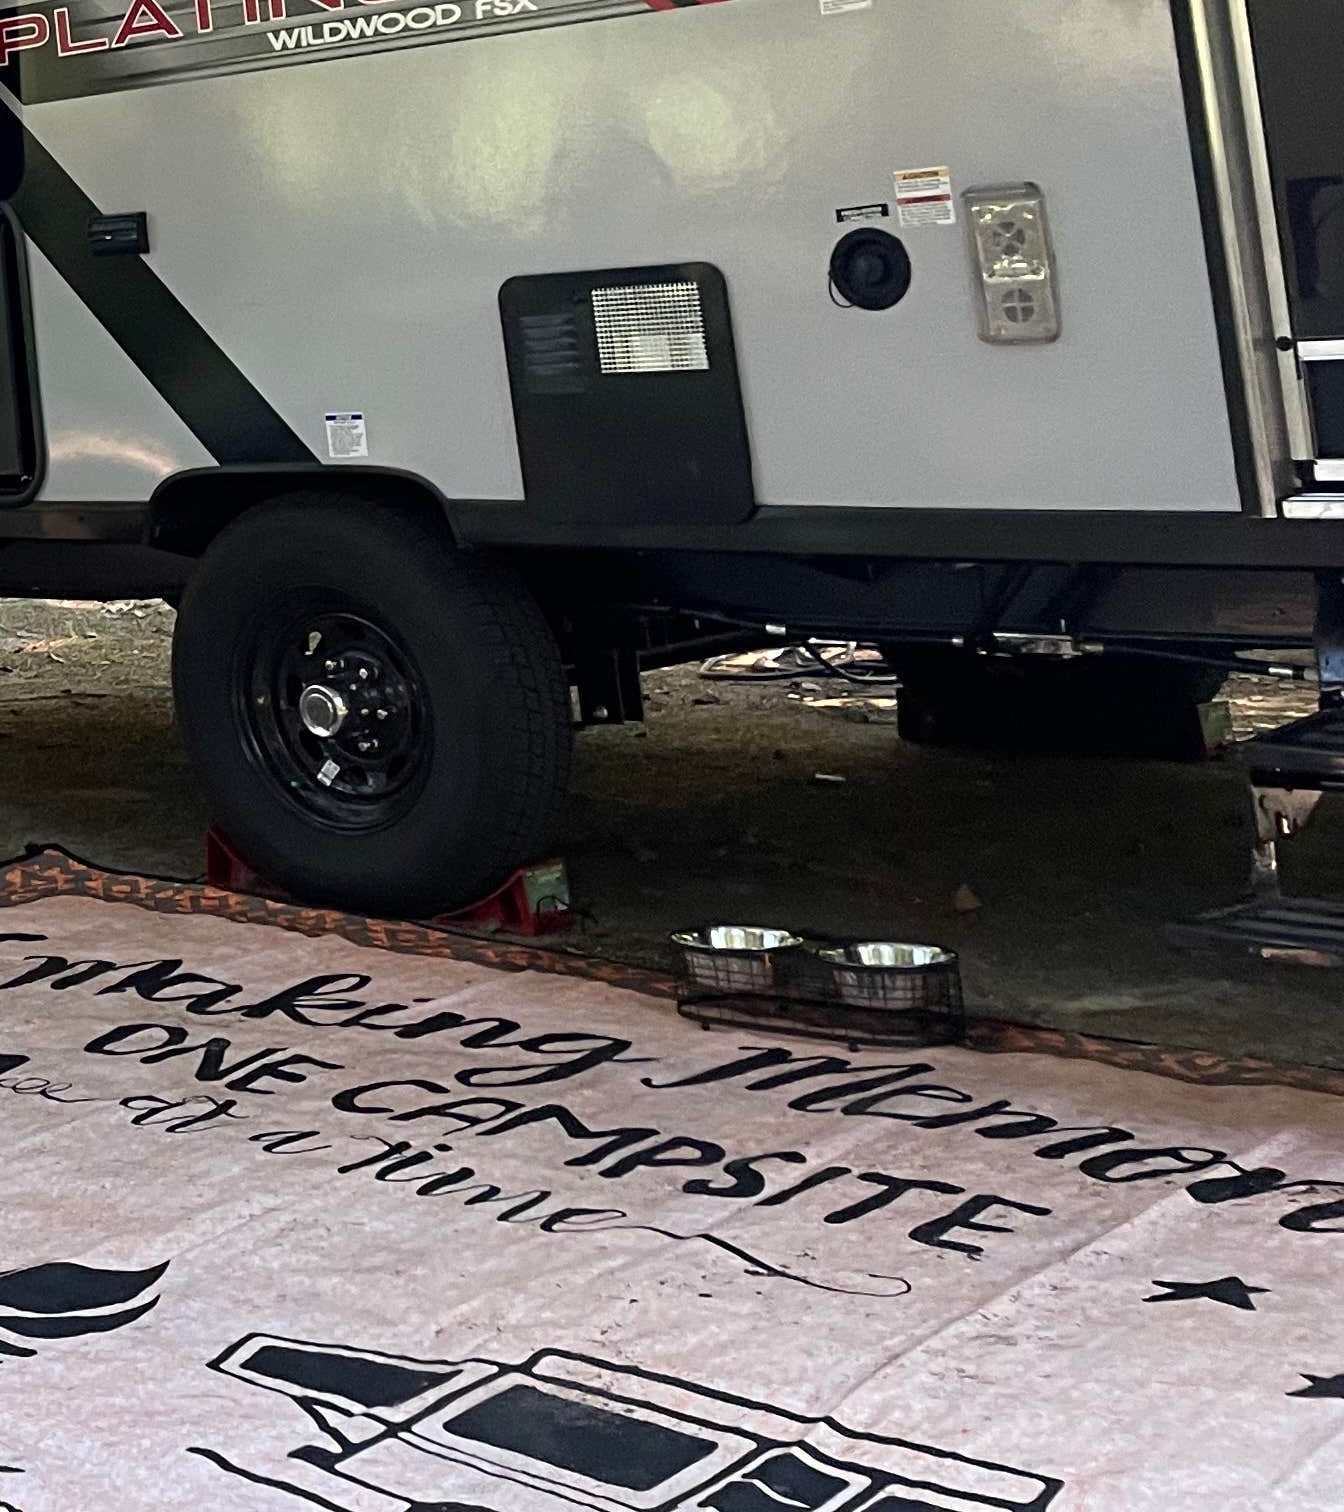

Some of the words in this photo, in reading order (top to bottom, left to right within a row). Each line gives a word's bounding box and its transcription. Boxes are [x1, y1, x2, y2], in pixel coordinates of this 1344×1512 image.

[267, 1, 462, 52] WILDWOOD
[84, 1023, 343, 1094] ONE
[331, 1079, 1053, 1261] CAMPSITE
[120, 1095, 249, 1134] at
[249, 1129, 332, 1155] a
